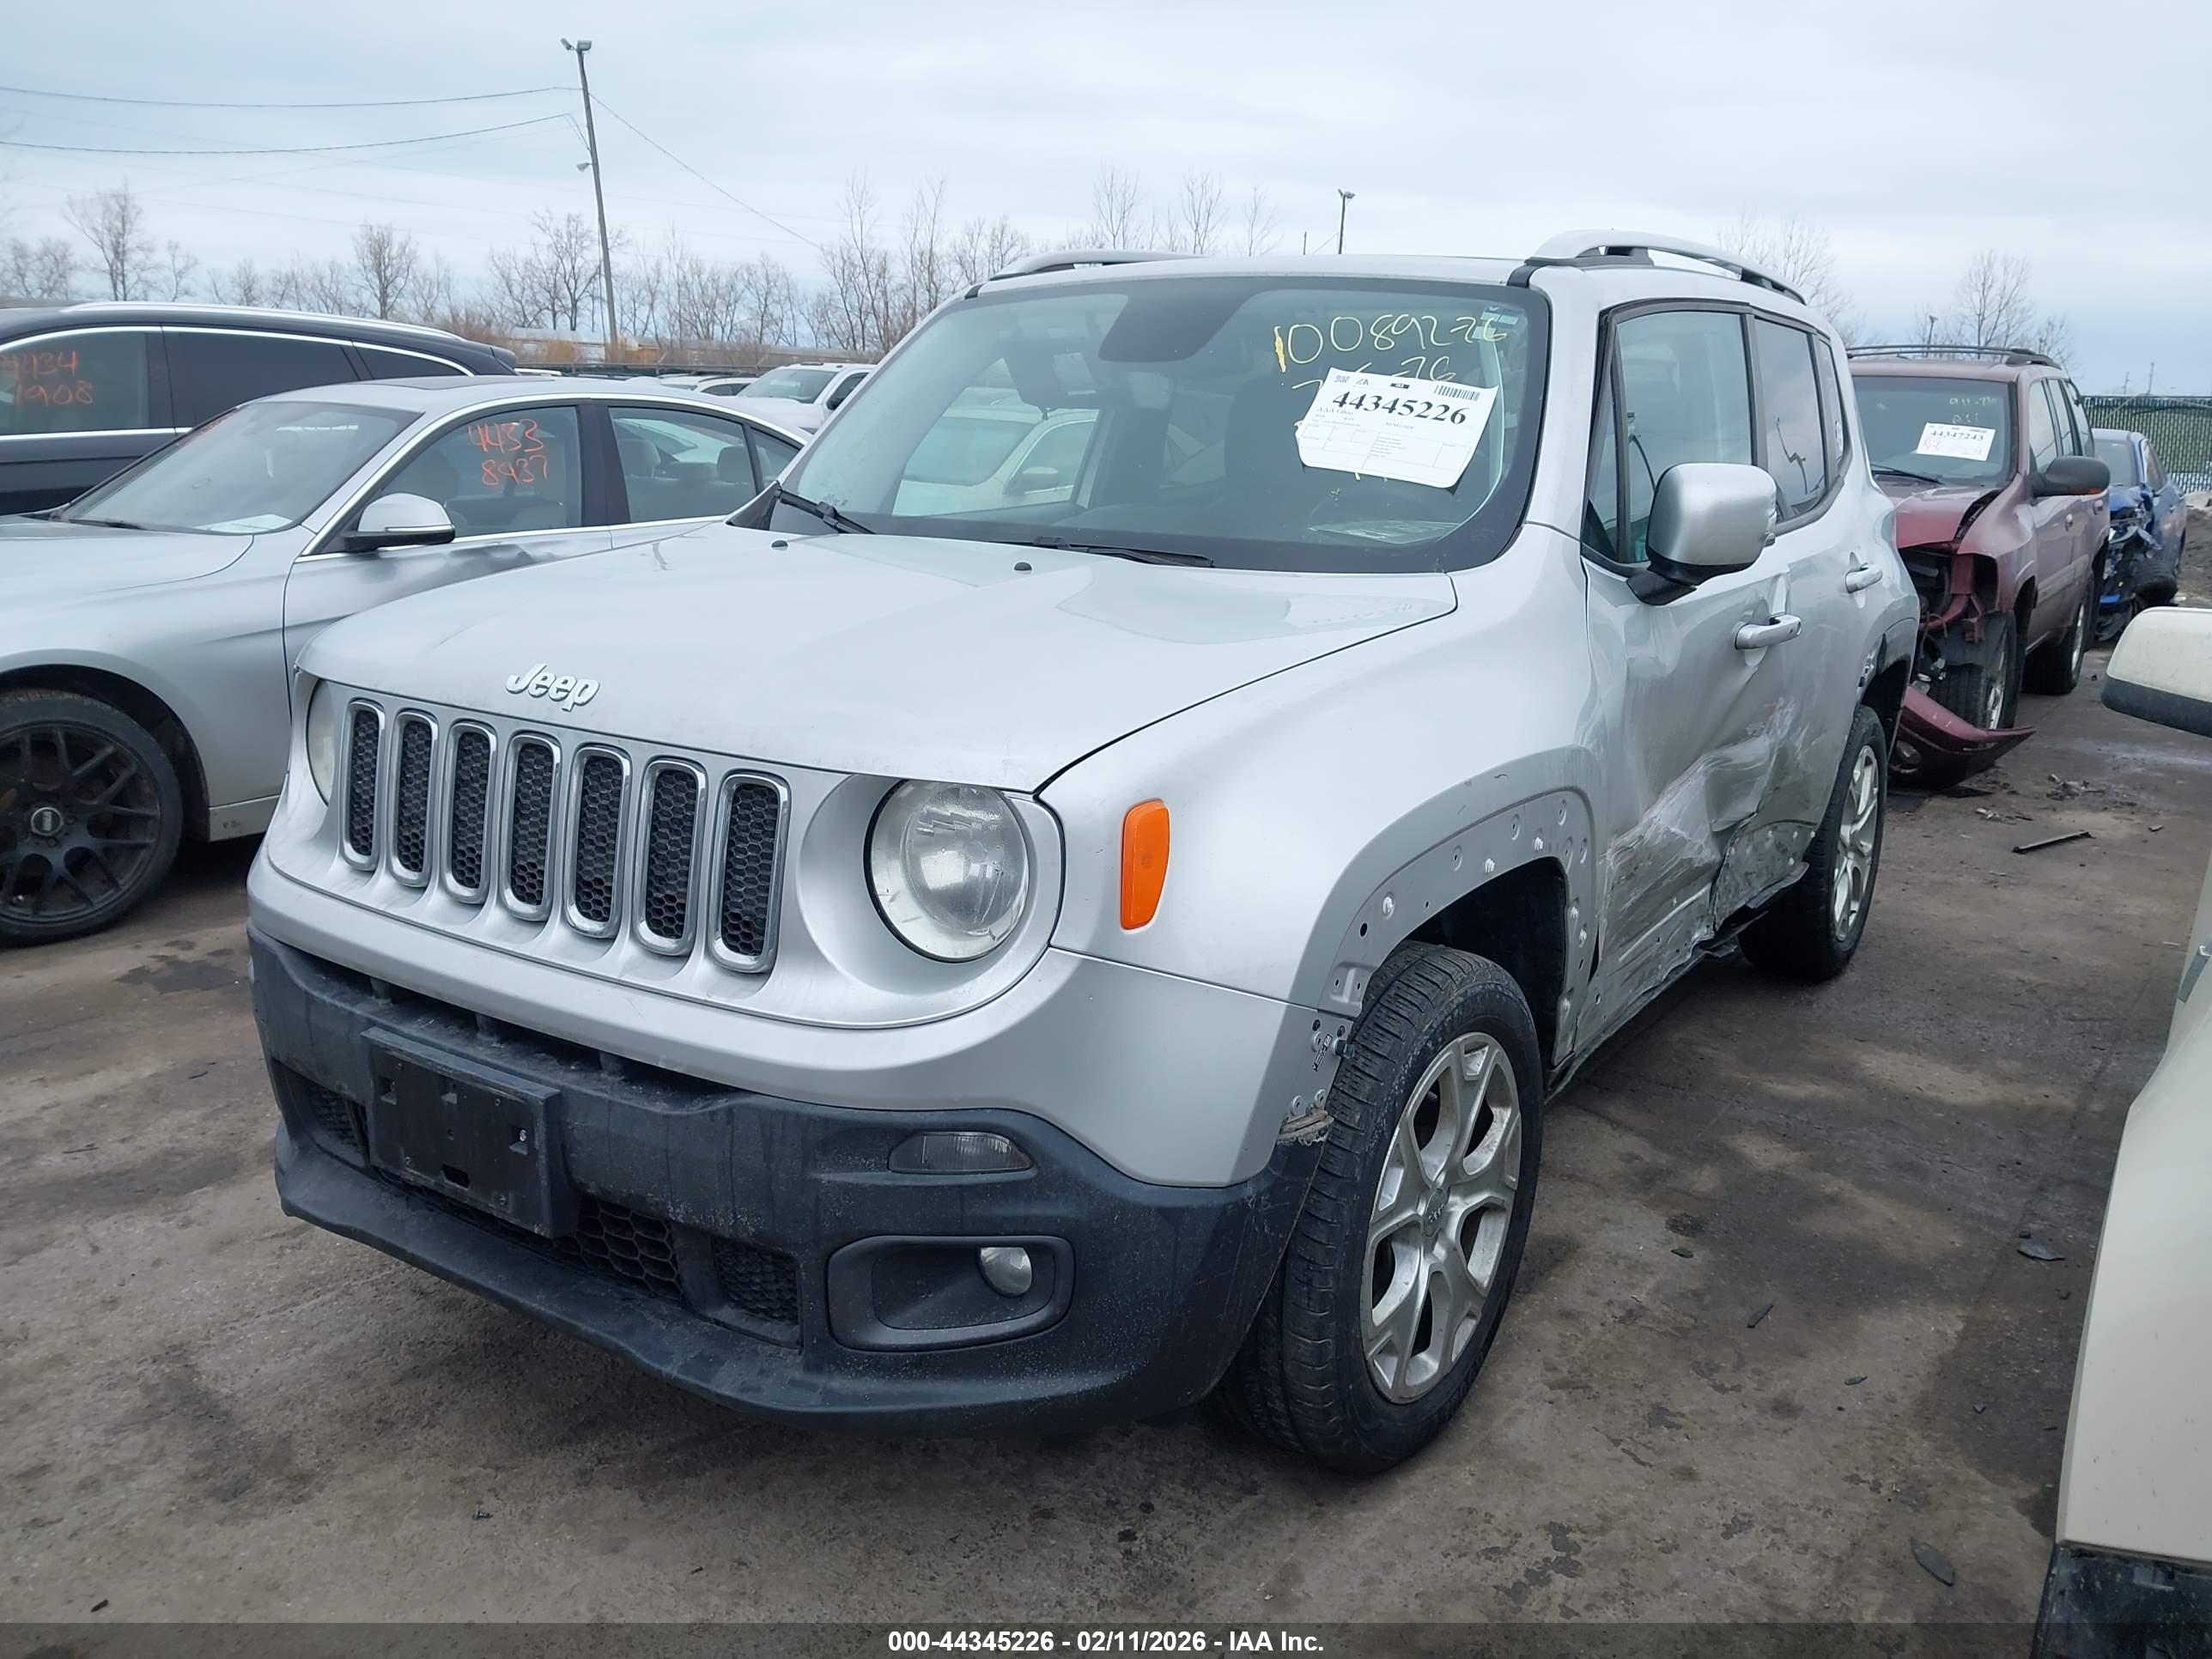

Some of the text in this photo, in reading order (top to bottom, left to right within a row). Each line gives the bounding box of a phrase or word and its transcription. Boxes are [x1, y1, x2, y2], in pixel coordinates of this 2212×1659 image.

[1333, 391, 1470, 425] 44345226
[467, 418, 544, 453] 4433
[507, 663, 599, 712] Jeep
